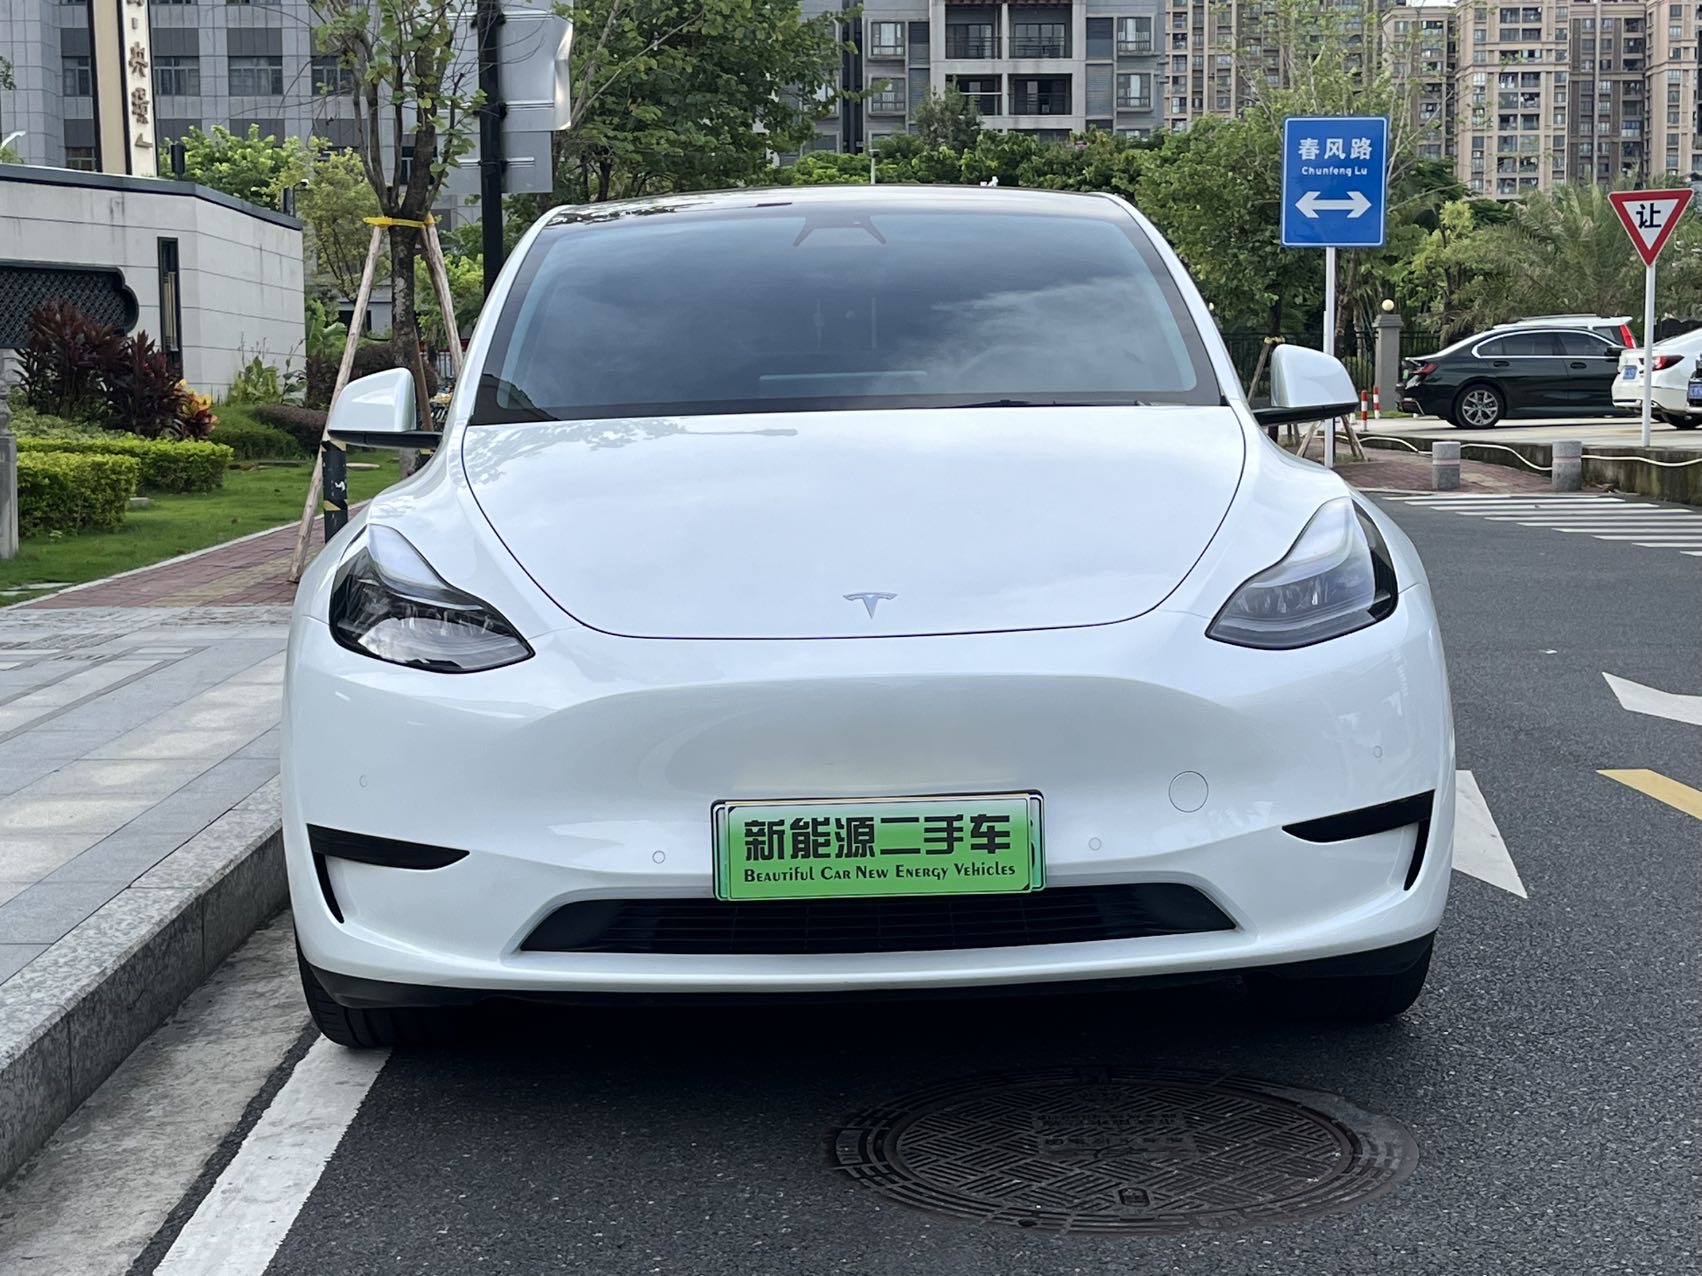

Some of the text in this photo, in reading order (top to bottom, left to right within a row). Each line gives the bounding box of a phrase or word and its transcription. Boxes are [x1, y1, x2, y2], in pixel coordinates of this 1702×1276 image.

[1298, 137, 1372, 160] 春风路
[1301, 166, 1368, 177] Chunfeng Lu
[1636, 202, 1662, 229] 让
[744, 813, 1012, 862] 新能源二手车
